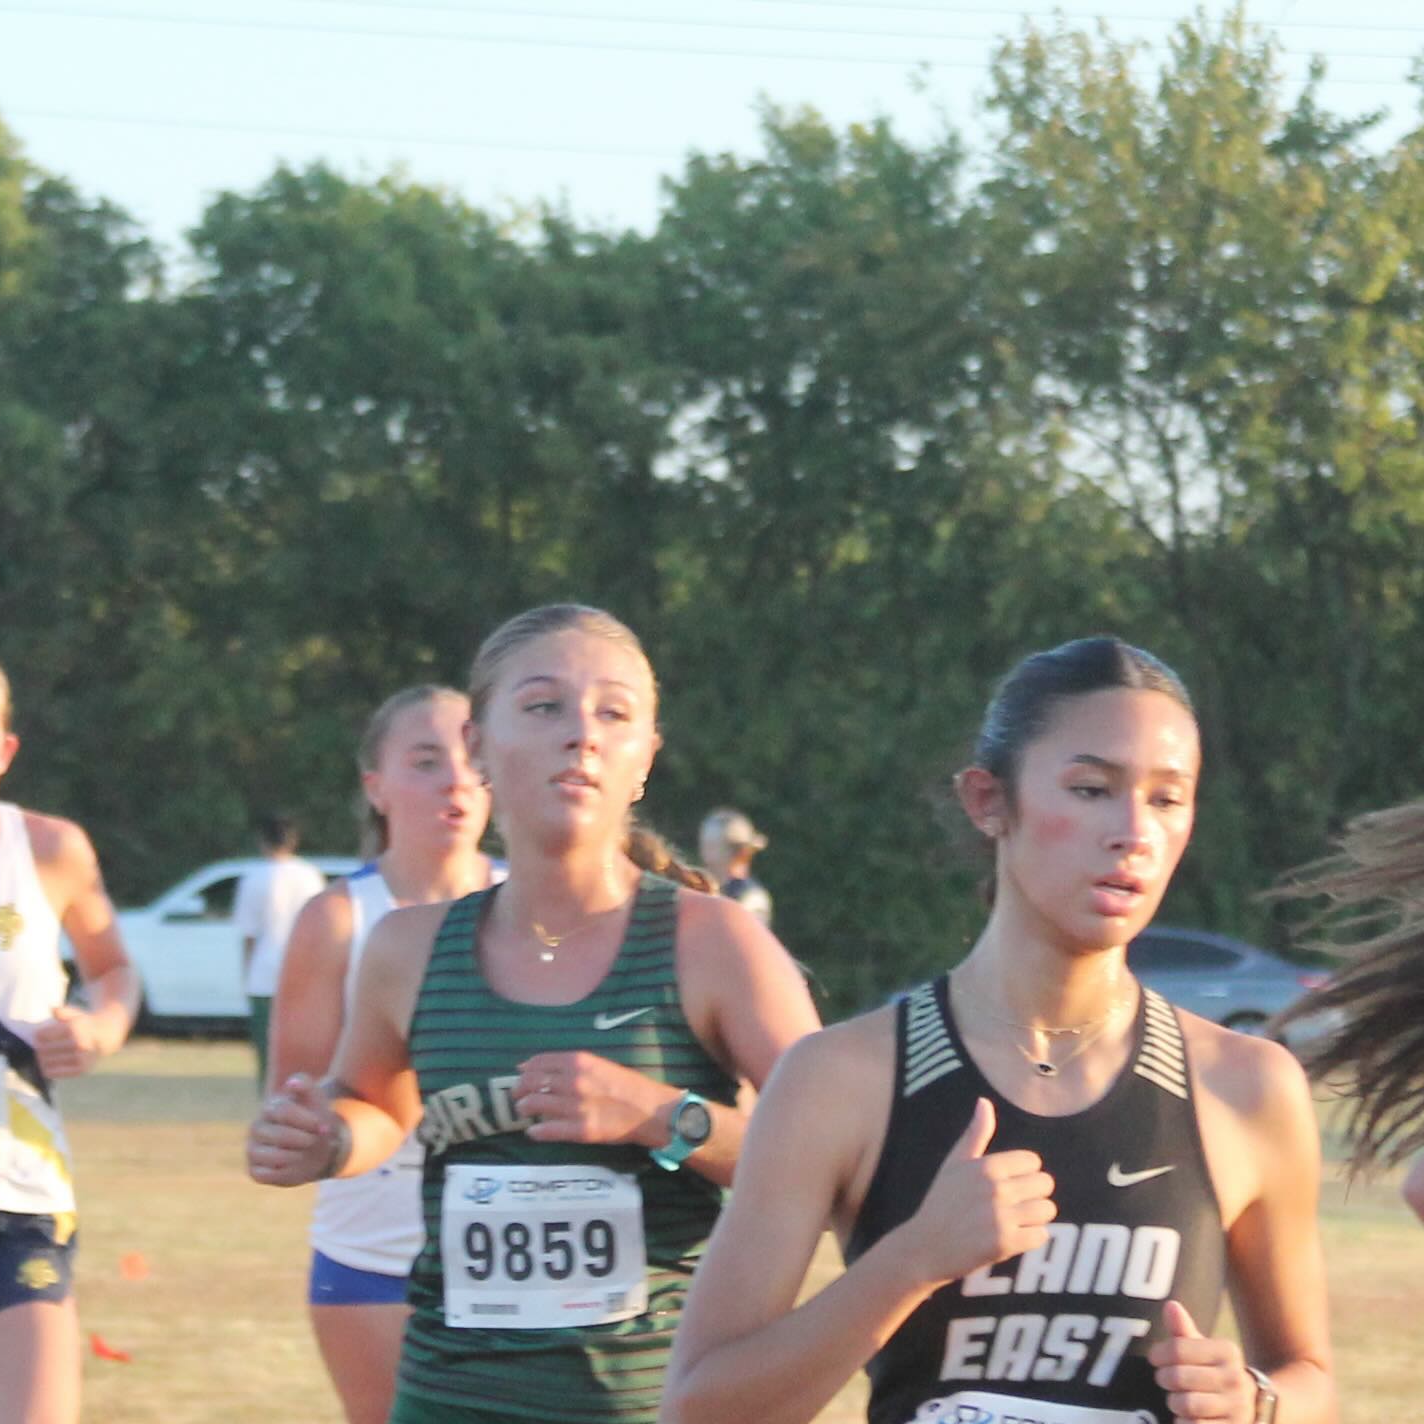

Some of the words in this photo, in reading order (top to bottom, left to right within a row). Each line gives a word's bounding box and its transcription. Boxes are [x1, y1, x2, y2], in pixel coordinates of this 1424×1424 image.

[465, 1219, 616, 1281] 9859
[961, 1223, 1181, 1300] LANO
[939, 1314, 1151, 1387] EAST
